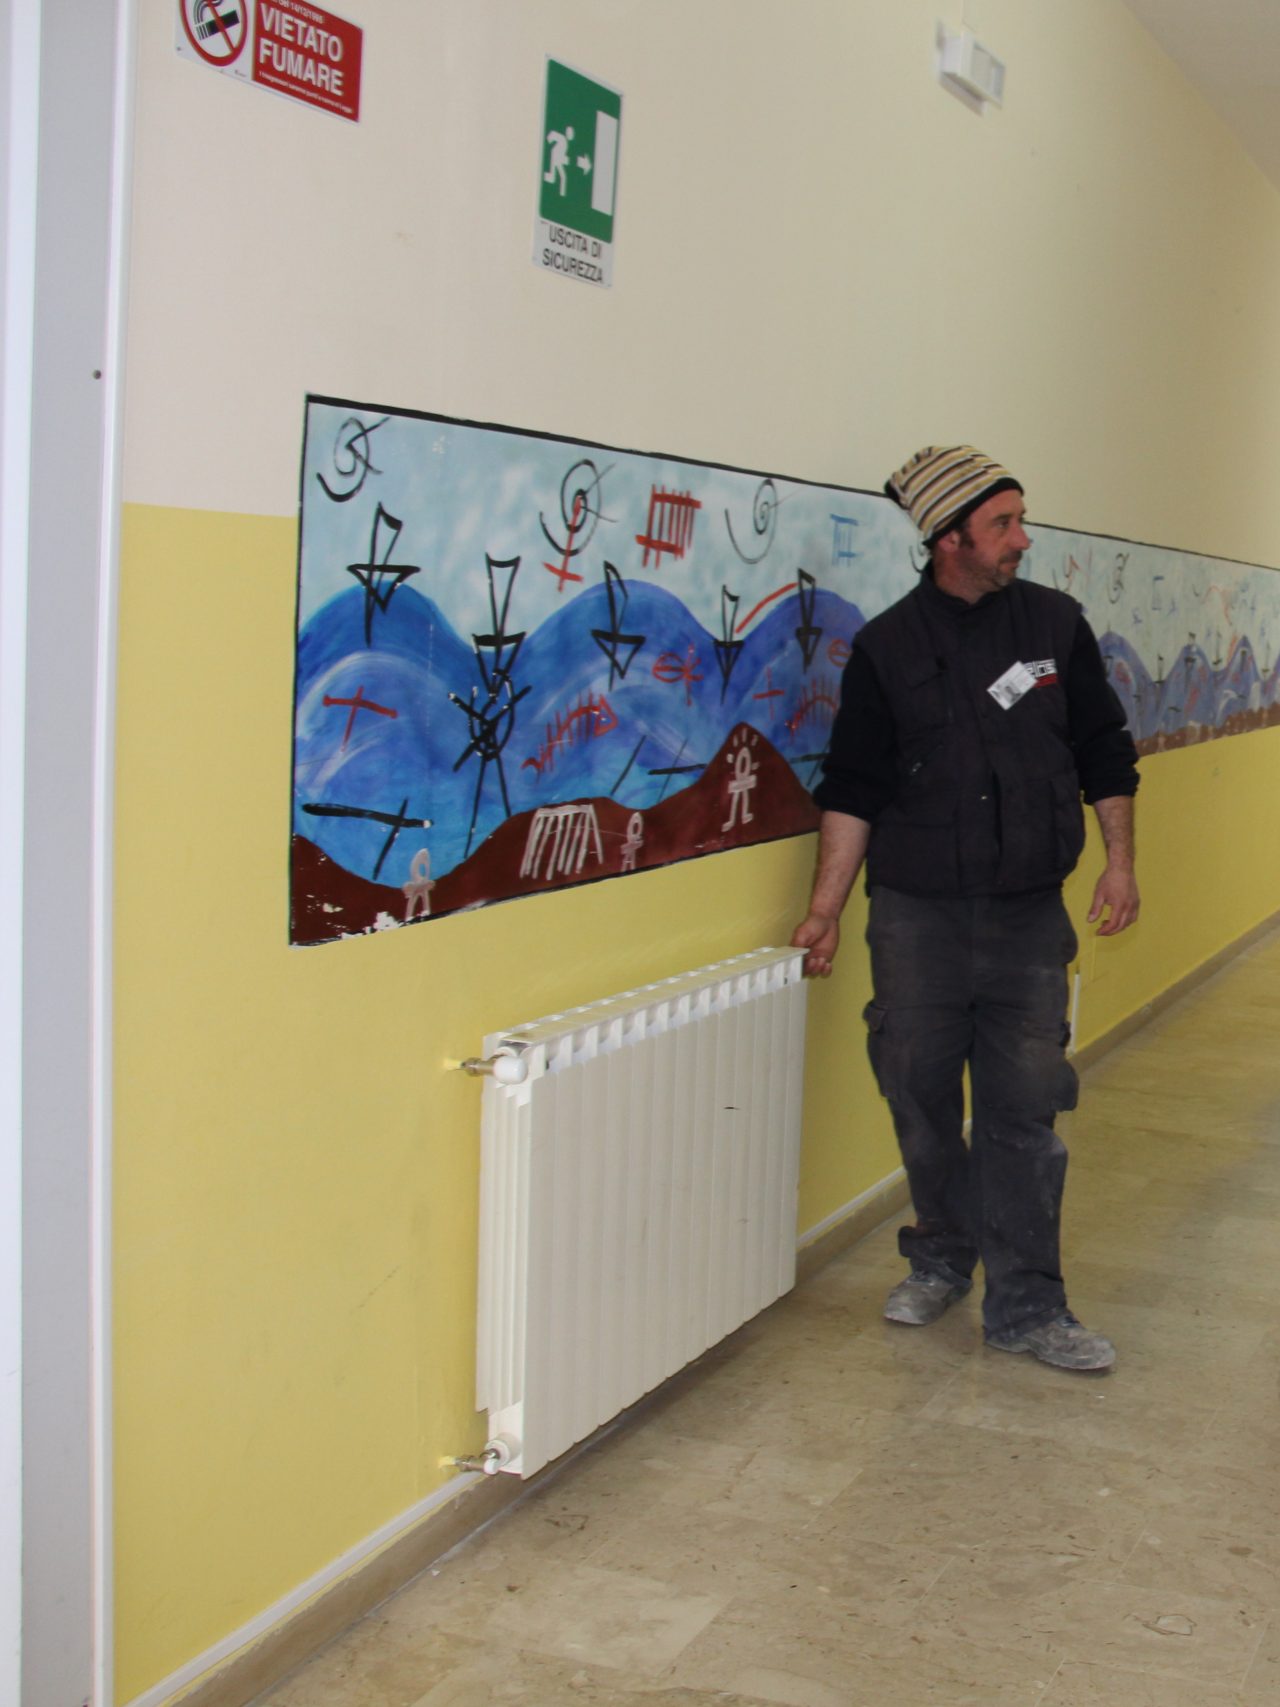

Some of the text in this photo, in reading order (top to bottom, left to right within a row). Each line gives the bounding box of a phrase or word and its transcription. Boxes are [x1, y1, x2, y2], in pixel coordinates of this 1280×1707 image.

[261, 2, 342, 62] VIETATO
[259, 37, 344, 96] FUMARE
[542, 247, 604, 284] SICUREZZA
[549, 224, 602, 260] USCITA DI
